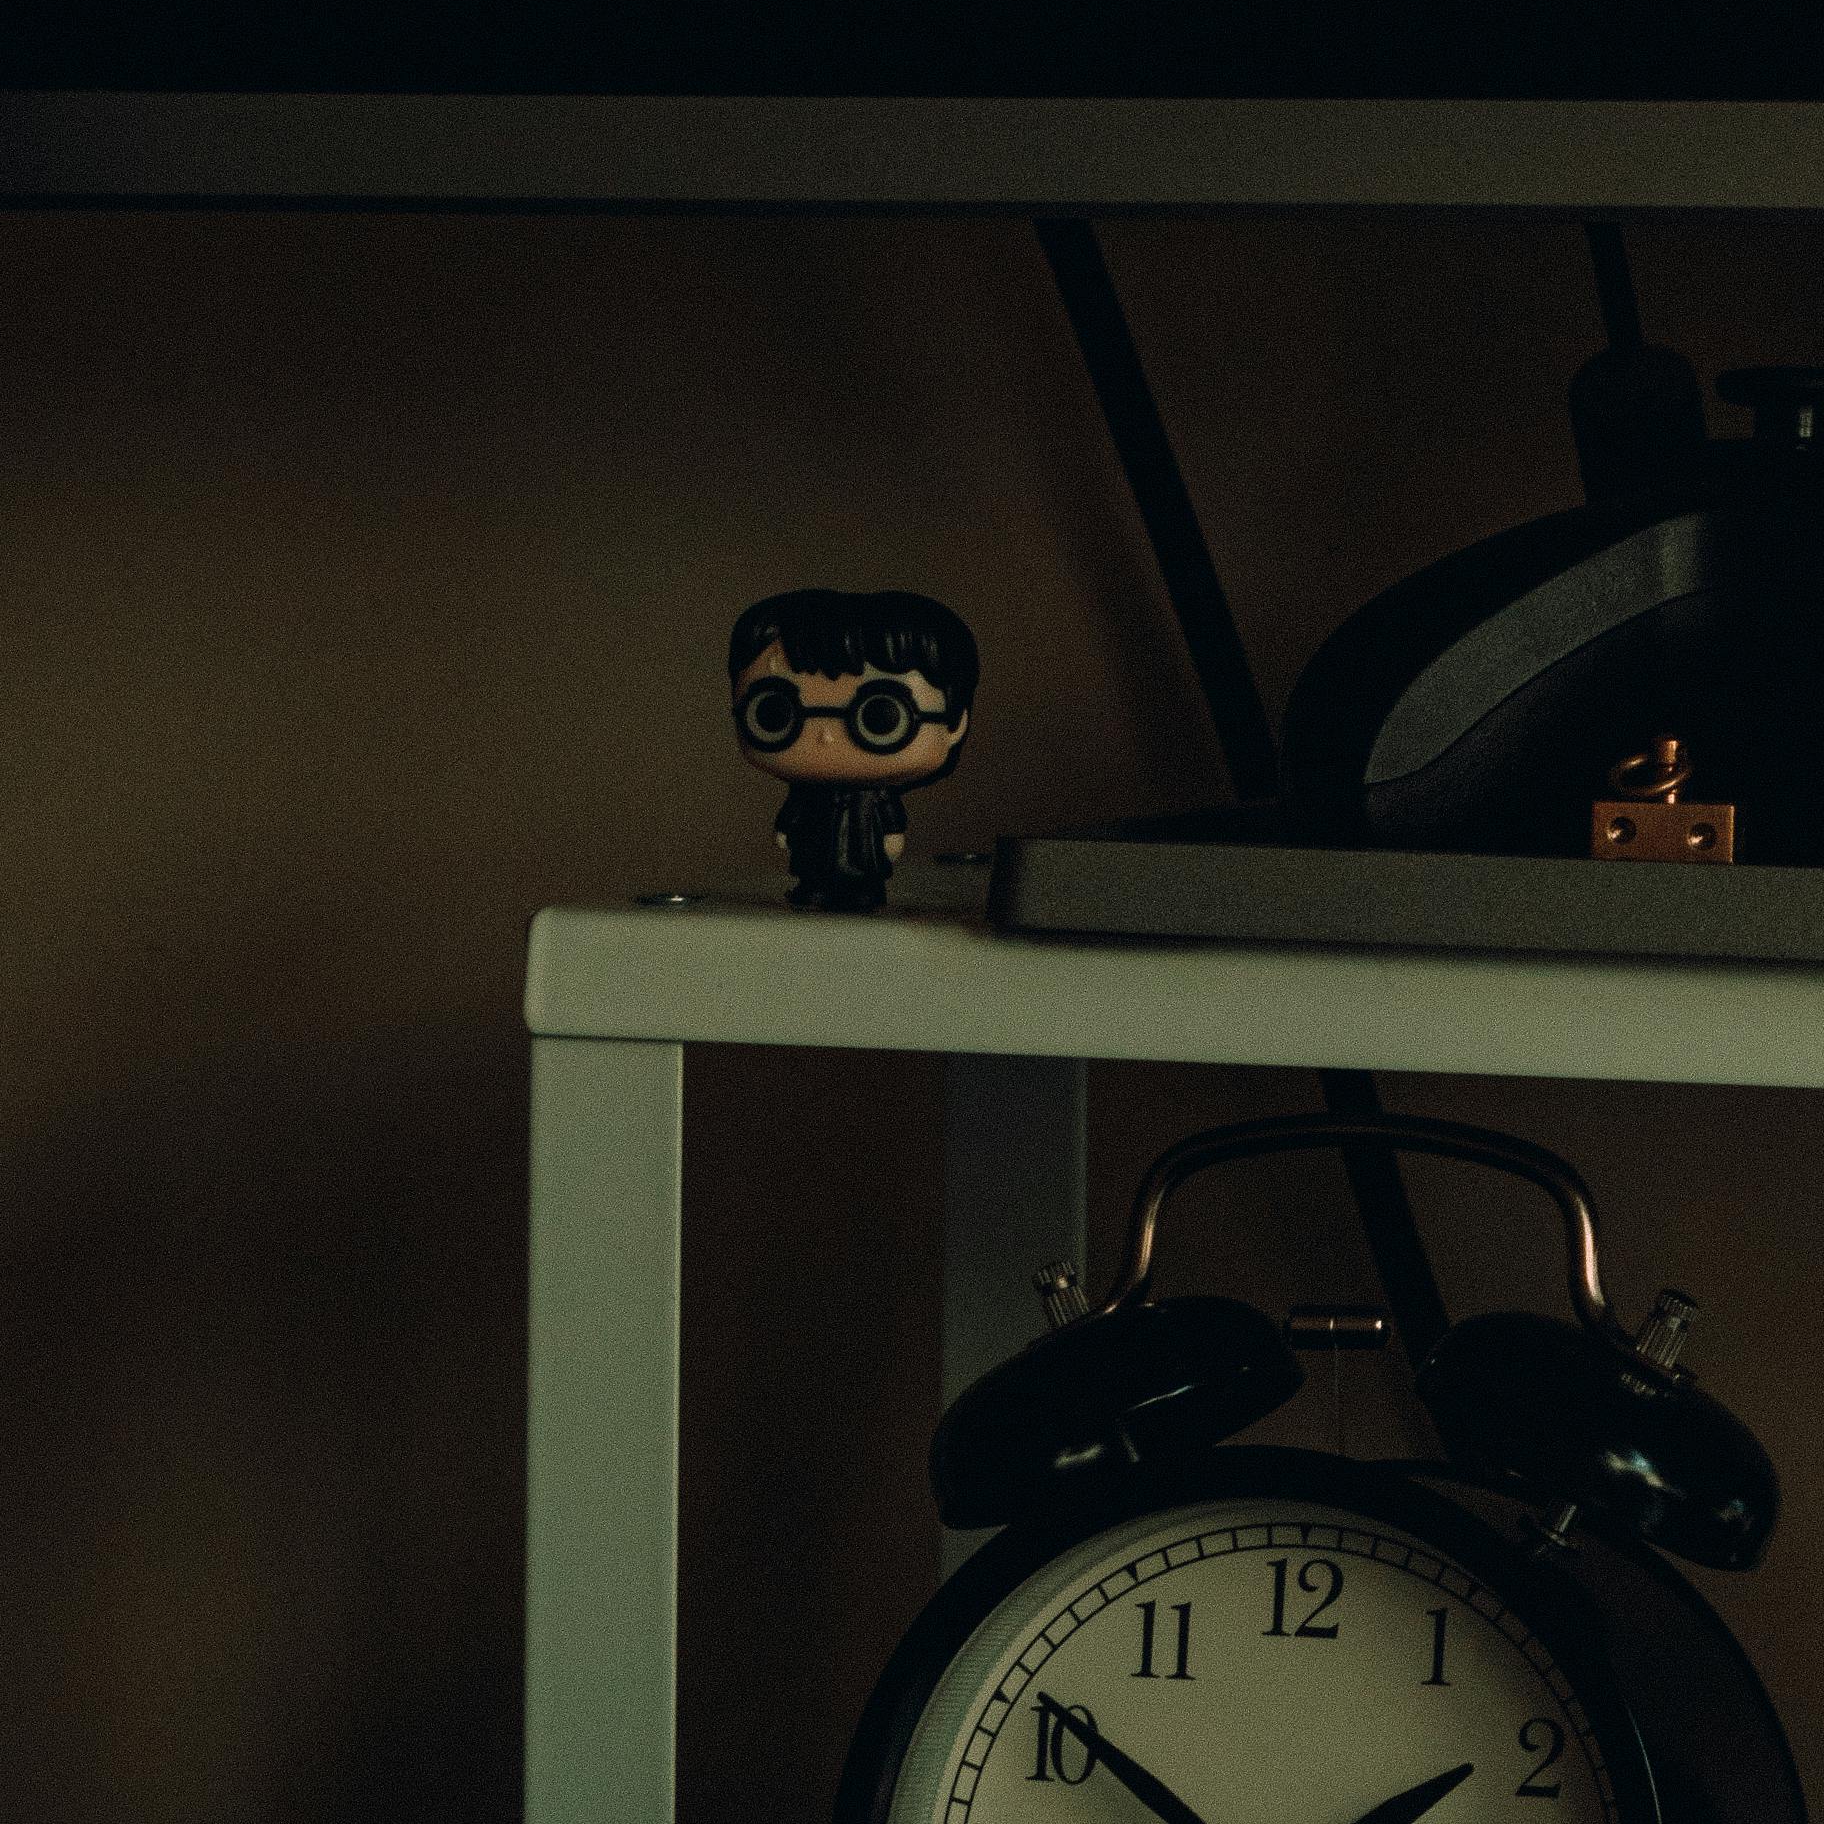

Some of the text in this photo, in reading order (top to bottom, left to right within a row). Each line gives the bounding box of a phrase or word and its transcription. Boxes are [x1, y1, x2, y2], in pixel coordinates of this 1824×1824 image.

[1261, 1558, 1344, 1640] 12
[1130, 1600, 1196, 1681] 11
[1421, 1607, 1451, 1686] 1
[1025, 1703, 1099, 1785] 10
[1515, 1717, 1566, 1797] 2
